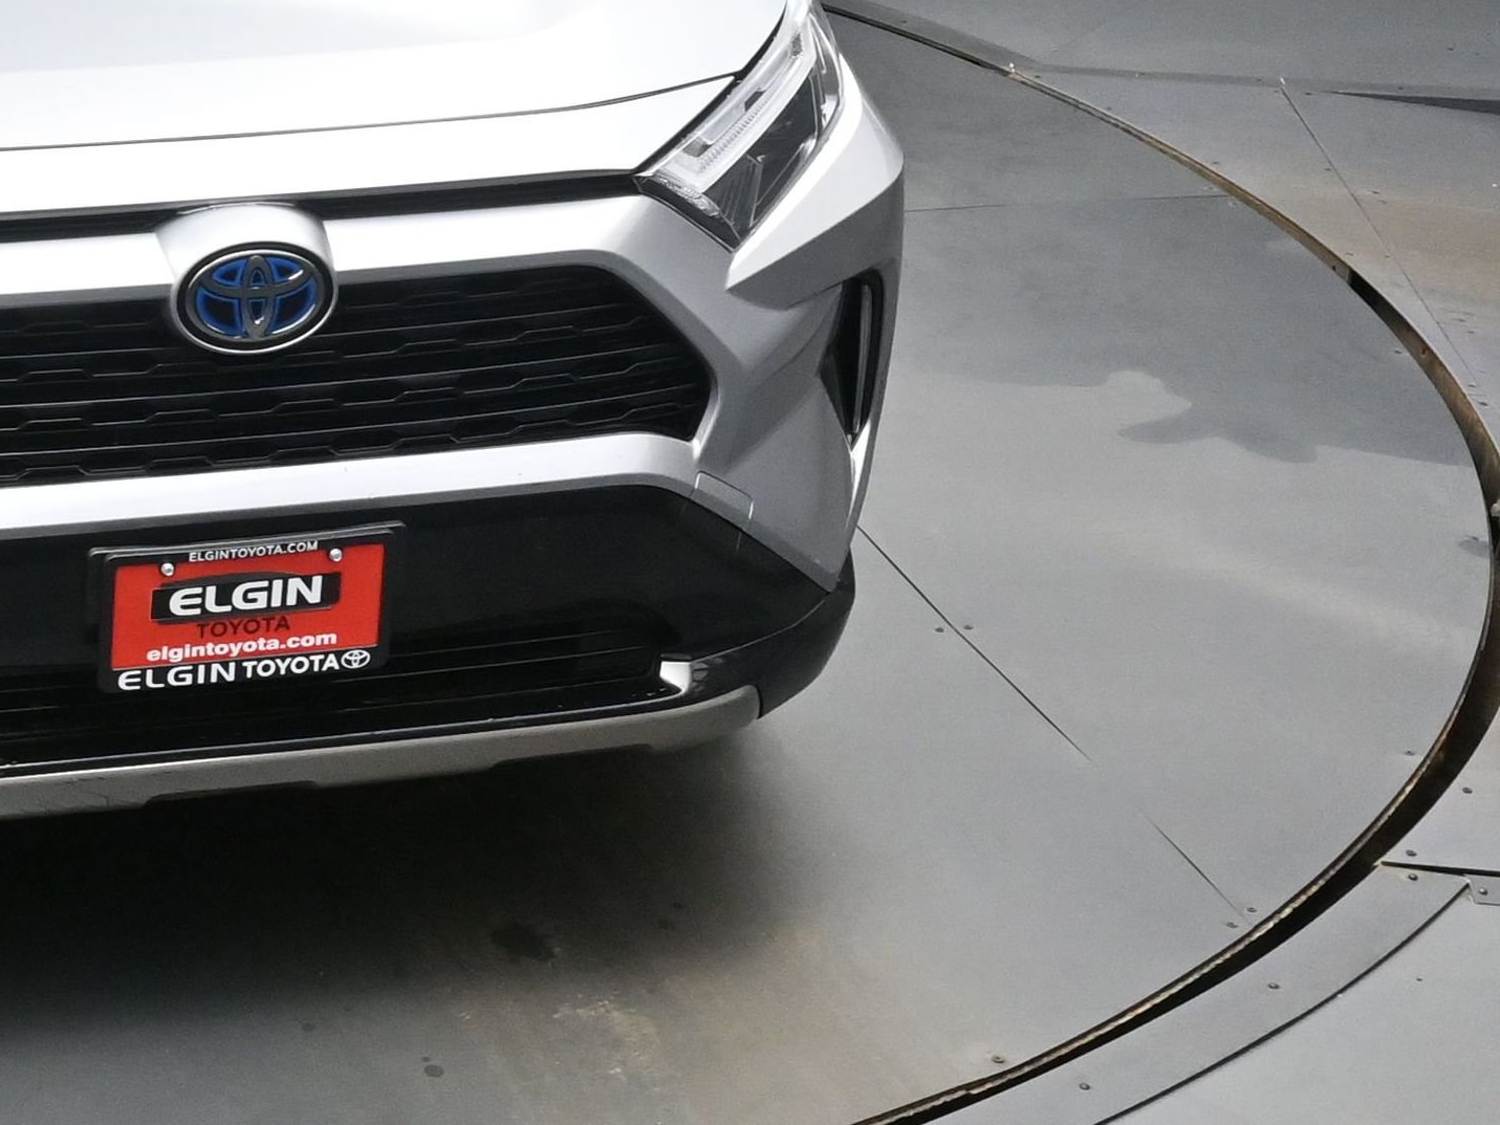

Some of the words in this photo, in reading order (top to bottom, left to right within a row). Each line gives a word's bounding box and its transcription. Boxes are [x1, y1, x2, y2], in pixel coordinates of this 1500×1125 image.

[188, 540, 318, 563] ELGINTOYOTA.COM
[169, 575, 323, 616] ELGIN
[197, 615, 291, 639] TOYOTA
[146, 632, 337, 663] elgintoyota.com
[117, 662, 236, 691] ELGIN
[242, 653, 340, 677] TOYOTA
